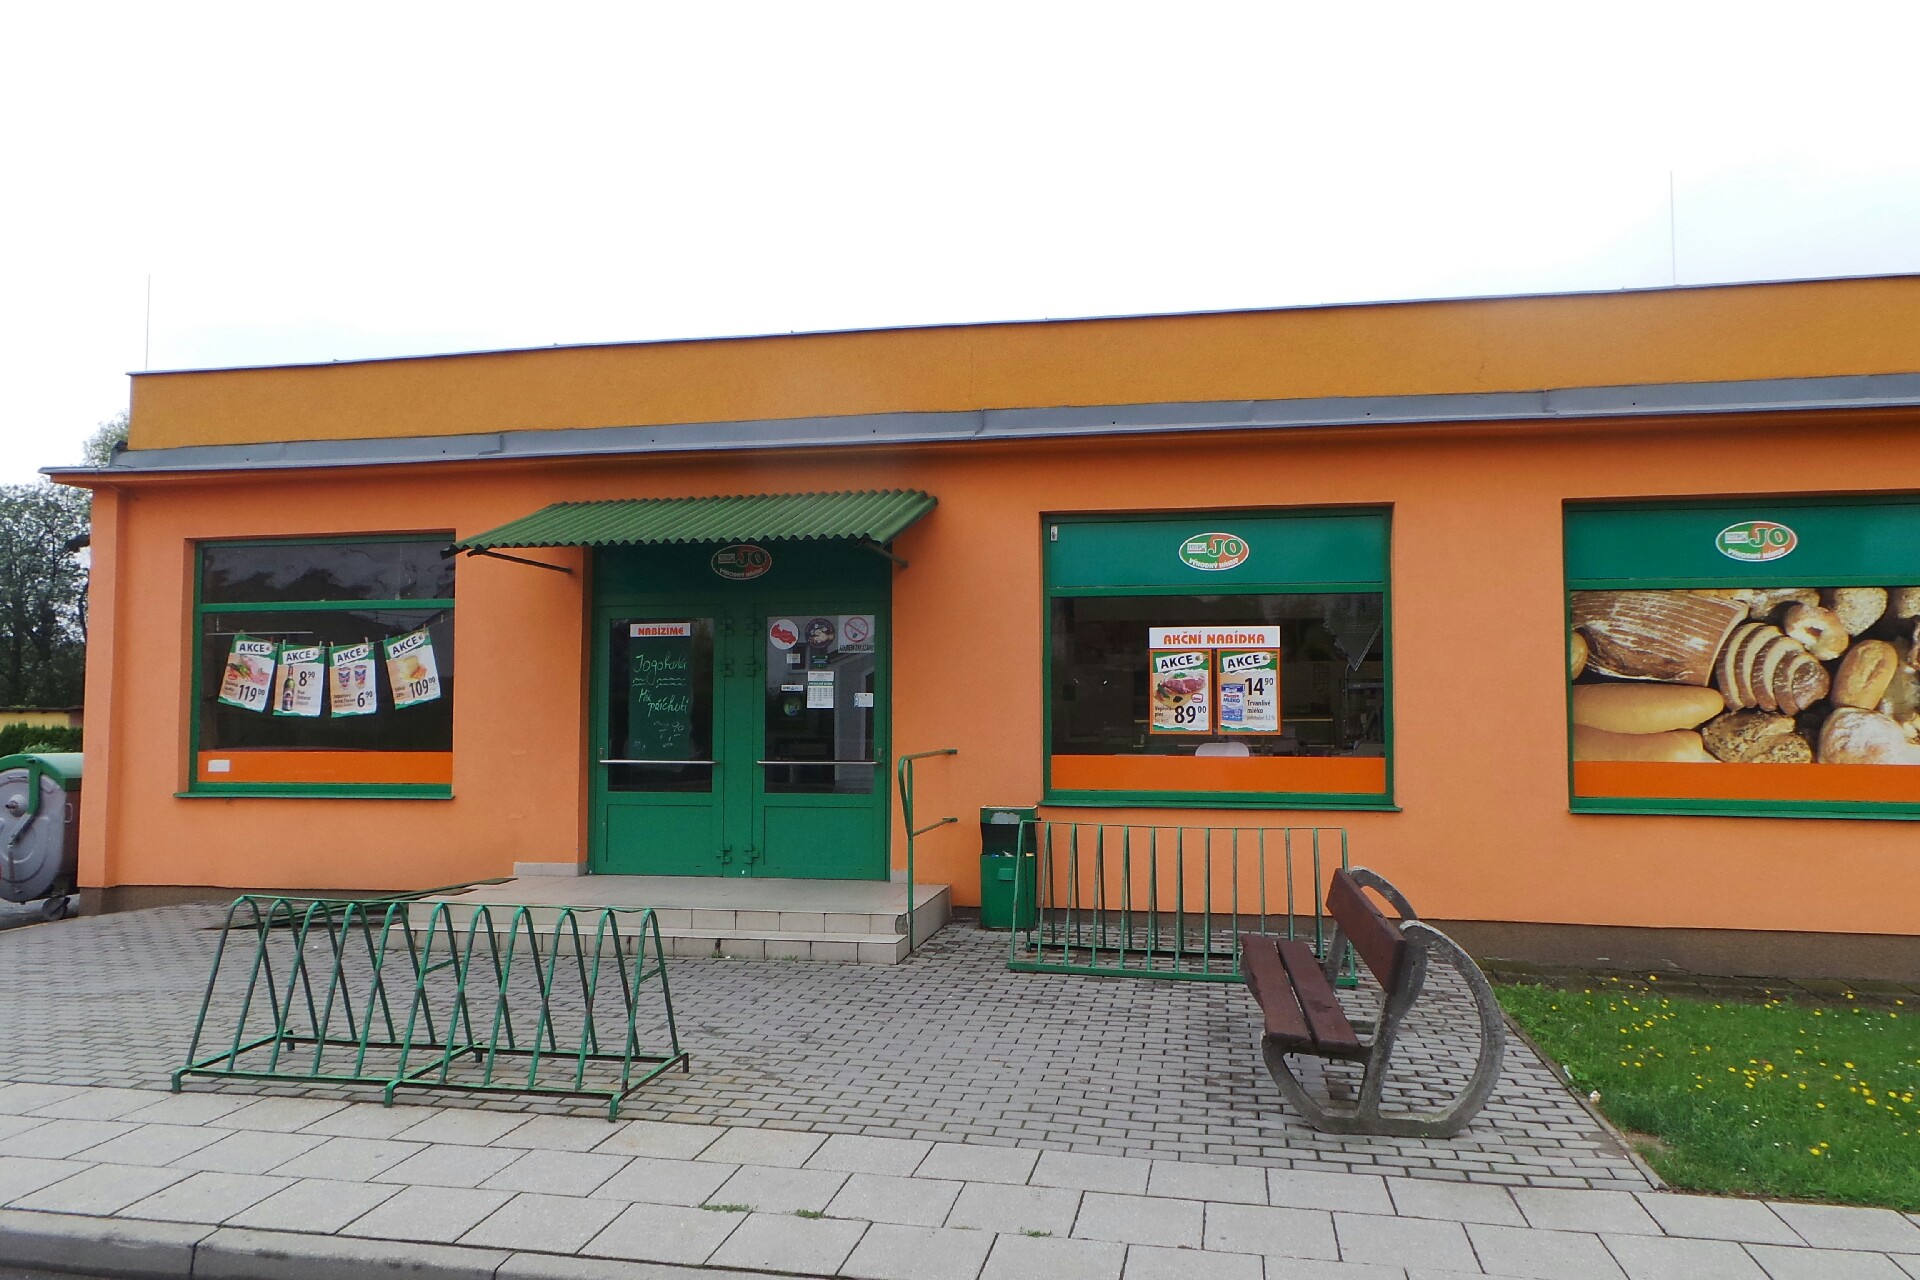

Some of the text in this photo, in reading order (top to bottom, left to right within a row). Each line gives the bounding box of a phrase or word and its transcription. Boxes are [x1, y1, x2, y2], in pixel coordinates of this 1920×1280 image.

[1748, 527, 1790, 547] JO
[1207, 538, 1243, 557] JO
[736, 550, 767, 567] JO
[392, 635, 418, 655] AKCE
[1163, 631, 1265, 645] AKČNÍ NABÍDKA
[239, 643, 265, 653] AKCE
[286, 650, 311, 662] AKCE
[337, 647, 362, 663] AKCE
[1161, 654, 1194, 669] AKCE
[1228, 654, 1260, 669] AKCE
[298, 671, 307, 687] 8
[1244, 677, 1264, 696] 14
[1264, 677, 1274, 686] 90
[238, 685, 257, 702] 119
[409, 680, 429, 699] 109
[357, 692, 366, 708] 6
[1174, 705, 1207, 724] 89 00
